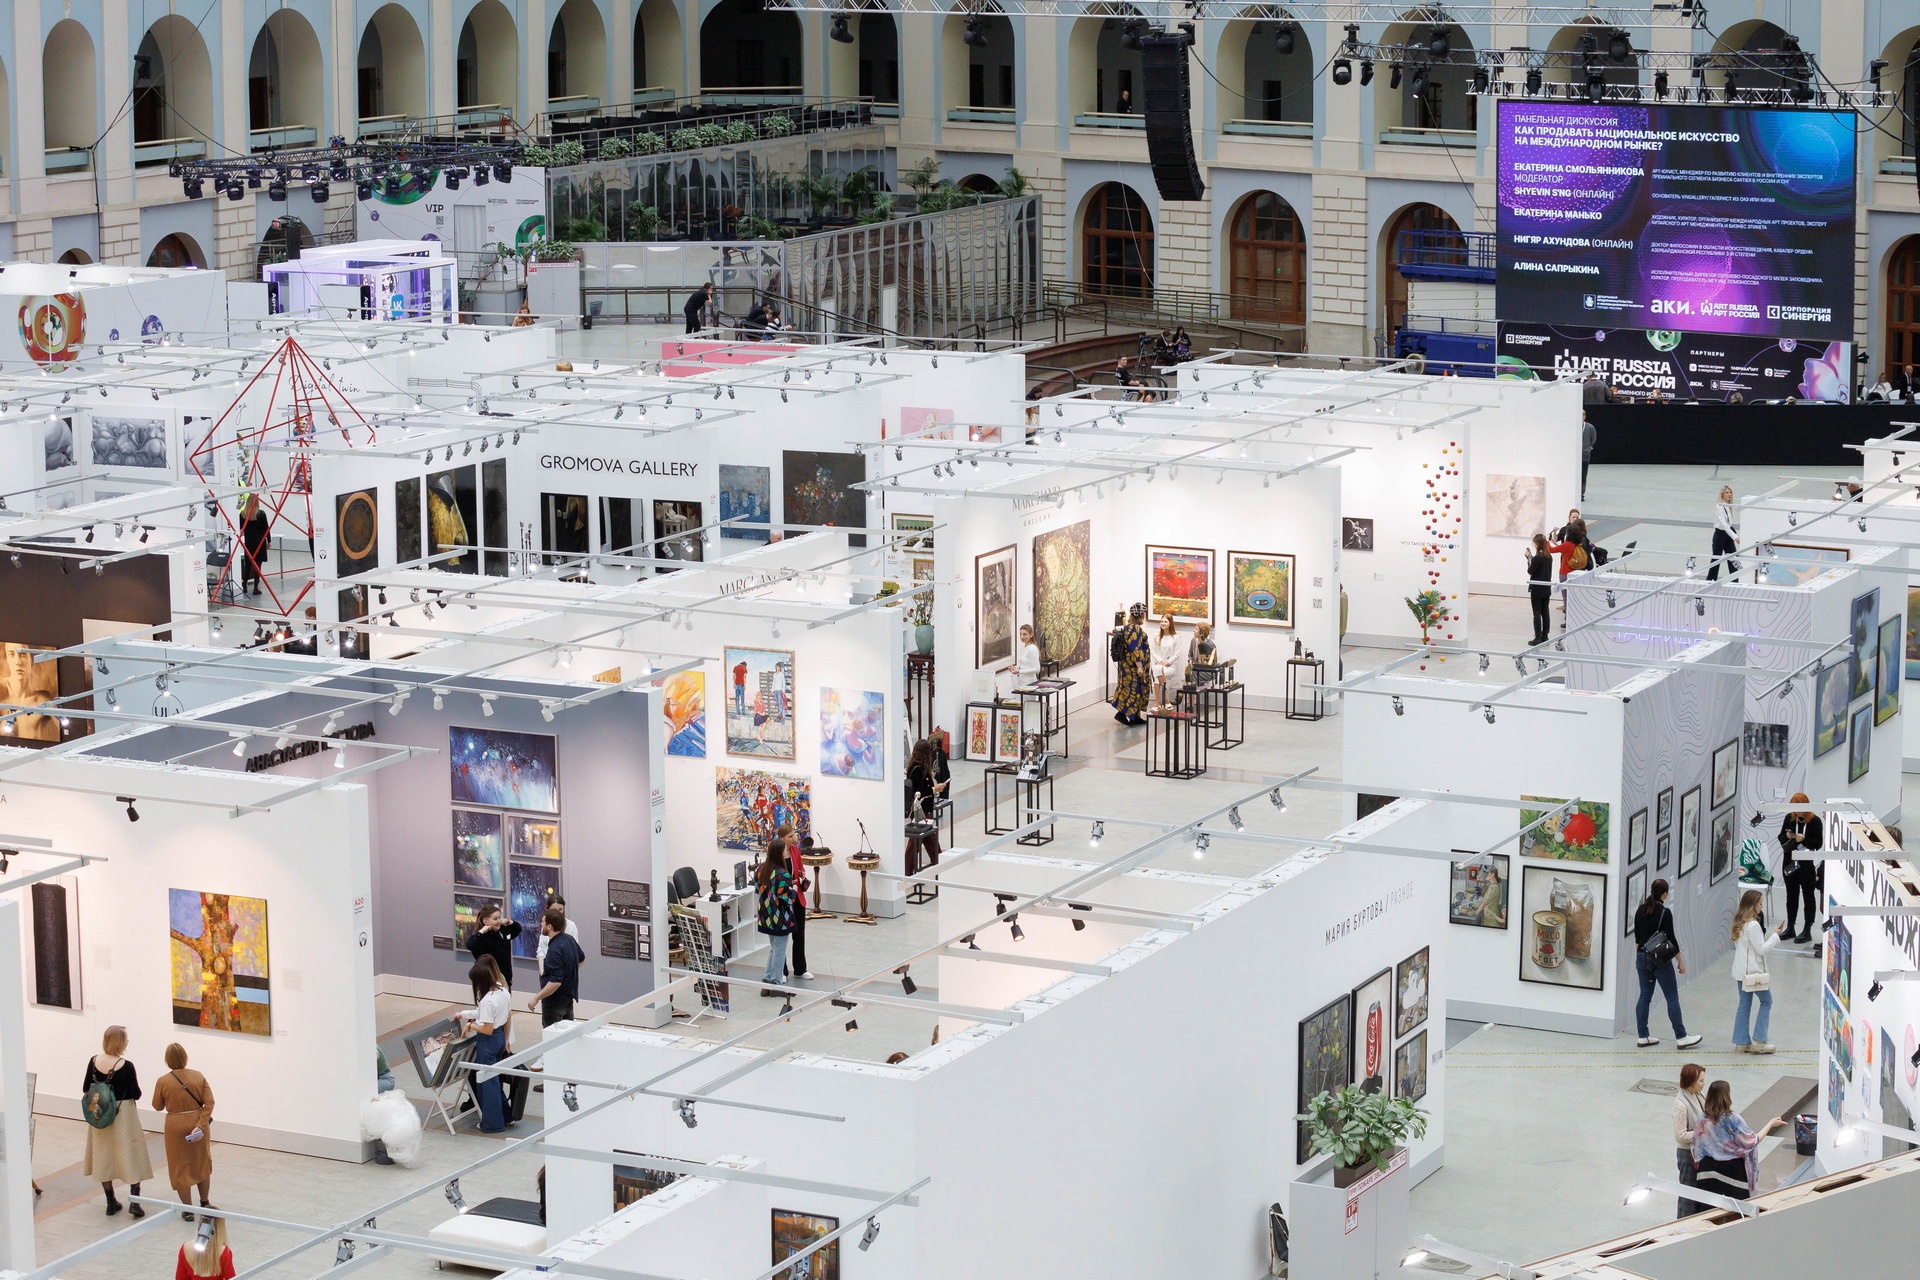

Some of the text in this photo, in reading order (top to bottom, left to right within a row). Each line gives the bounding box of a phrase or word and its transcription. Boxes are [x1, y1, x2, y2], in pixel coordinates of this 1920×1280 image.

[1514, 114, 1618, 126] ПАНЕЛЬНАЯ ДИСКУССИЯ
[1514, 126, 1740, 143] КАК ПРОДАВАТЬ НАЦИОНАЛЬНОЕ ИСКУССТВО
[1514, 136, 1663, 151] НА МЕЖДУНАРОДНОМ РЫНКЕ?
[1514, 163, 1645, 176] ЕКАТЕРИНА СМОЛЬЯННИКОВА
[1514, 174, 1564, 184] МОДЕРАТОР
[1514, 187, 1551, 196] SHYEVIN
[1573, 189, 1614, 200] (ОНЛАЙН)
[425, 204, 444, 212] VIP
[1514, 208, 1602, 220] ЕКАТЕРИНА МАНЬКО
[1514, 235, 1634, 250] НИГЯР АХУНДОВА (ОНЛАЙН)
[1514, 262, 1600, 274] АЛИНА САПРЫКИНА
[1650, 299, 1696, 315] аки.
[1728, 304, 1758, 312] RUSSIA
[1782, 306, 1832, 314] КОРПОРАЦИЯ
[1728, 310, 1760, 319] РОССИЯ
[1782, 312, 1832, 322] СИНЕРГИЯ
[1515, 334, 1550, 342] КОРПОРАЦИЯ
[1690, 350, 1725, 358] ПАРТНЕРЫ
[1580, 356, 1672, 375] ART RUSSIA
[1612, 373, 1676, 390] РОССИЯ
[540, 454, 698, 477] GROMOVA GALLERY
[245, 740, 320, 772] АНАСТАСИЯ
[1830, 811, 1920, 972] ЮНЫЕ ХУДОЖ
[1325, 918, 1350, 946] МАРИЯ
[1354, 900, 1384, 930] БУРТОВА
[1390, 880, 1414, 908] РАЗНОЕ
[1537, 928, 1560, 940] МЯСО
[1538, 955, 1559, 964] ГОСТ
